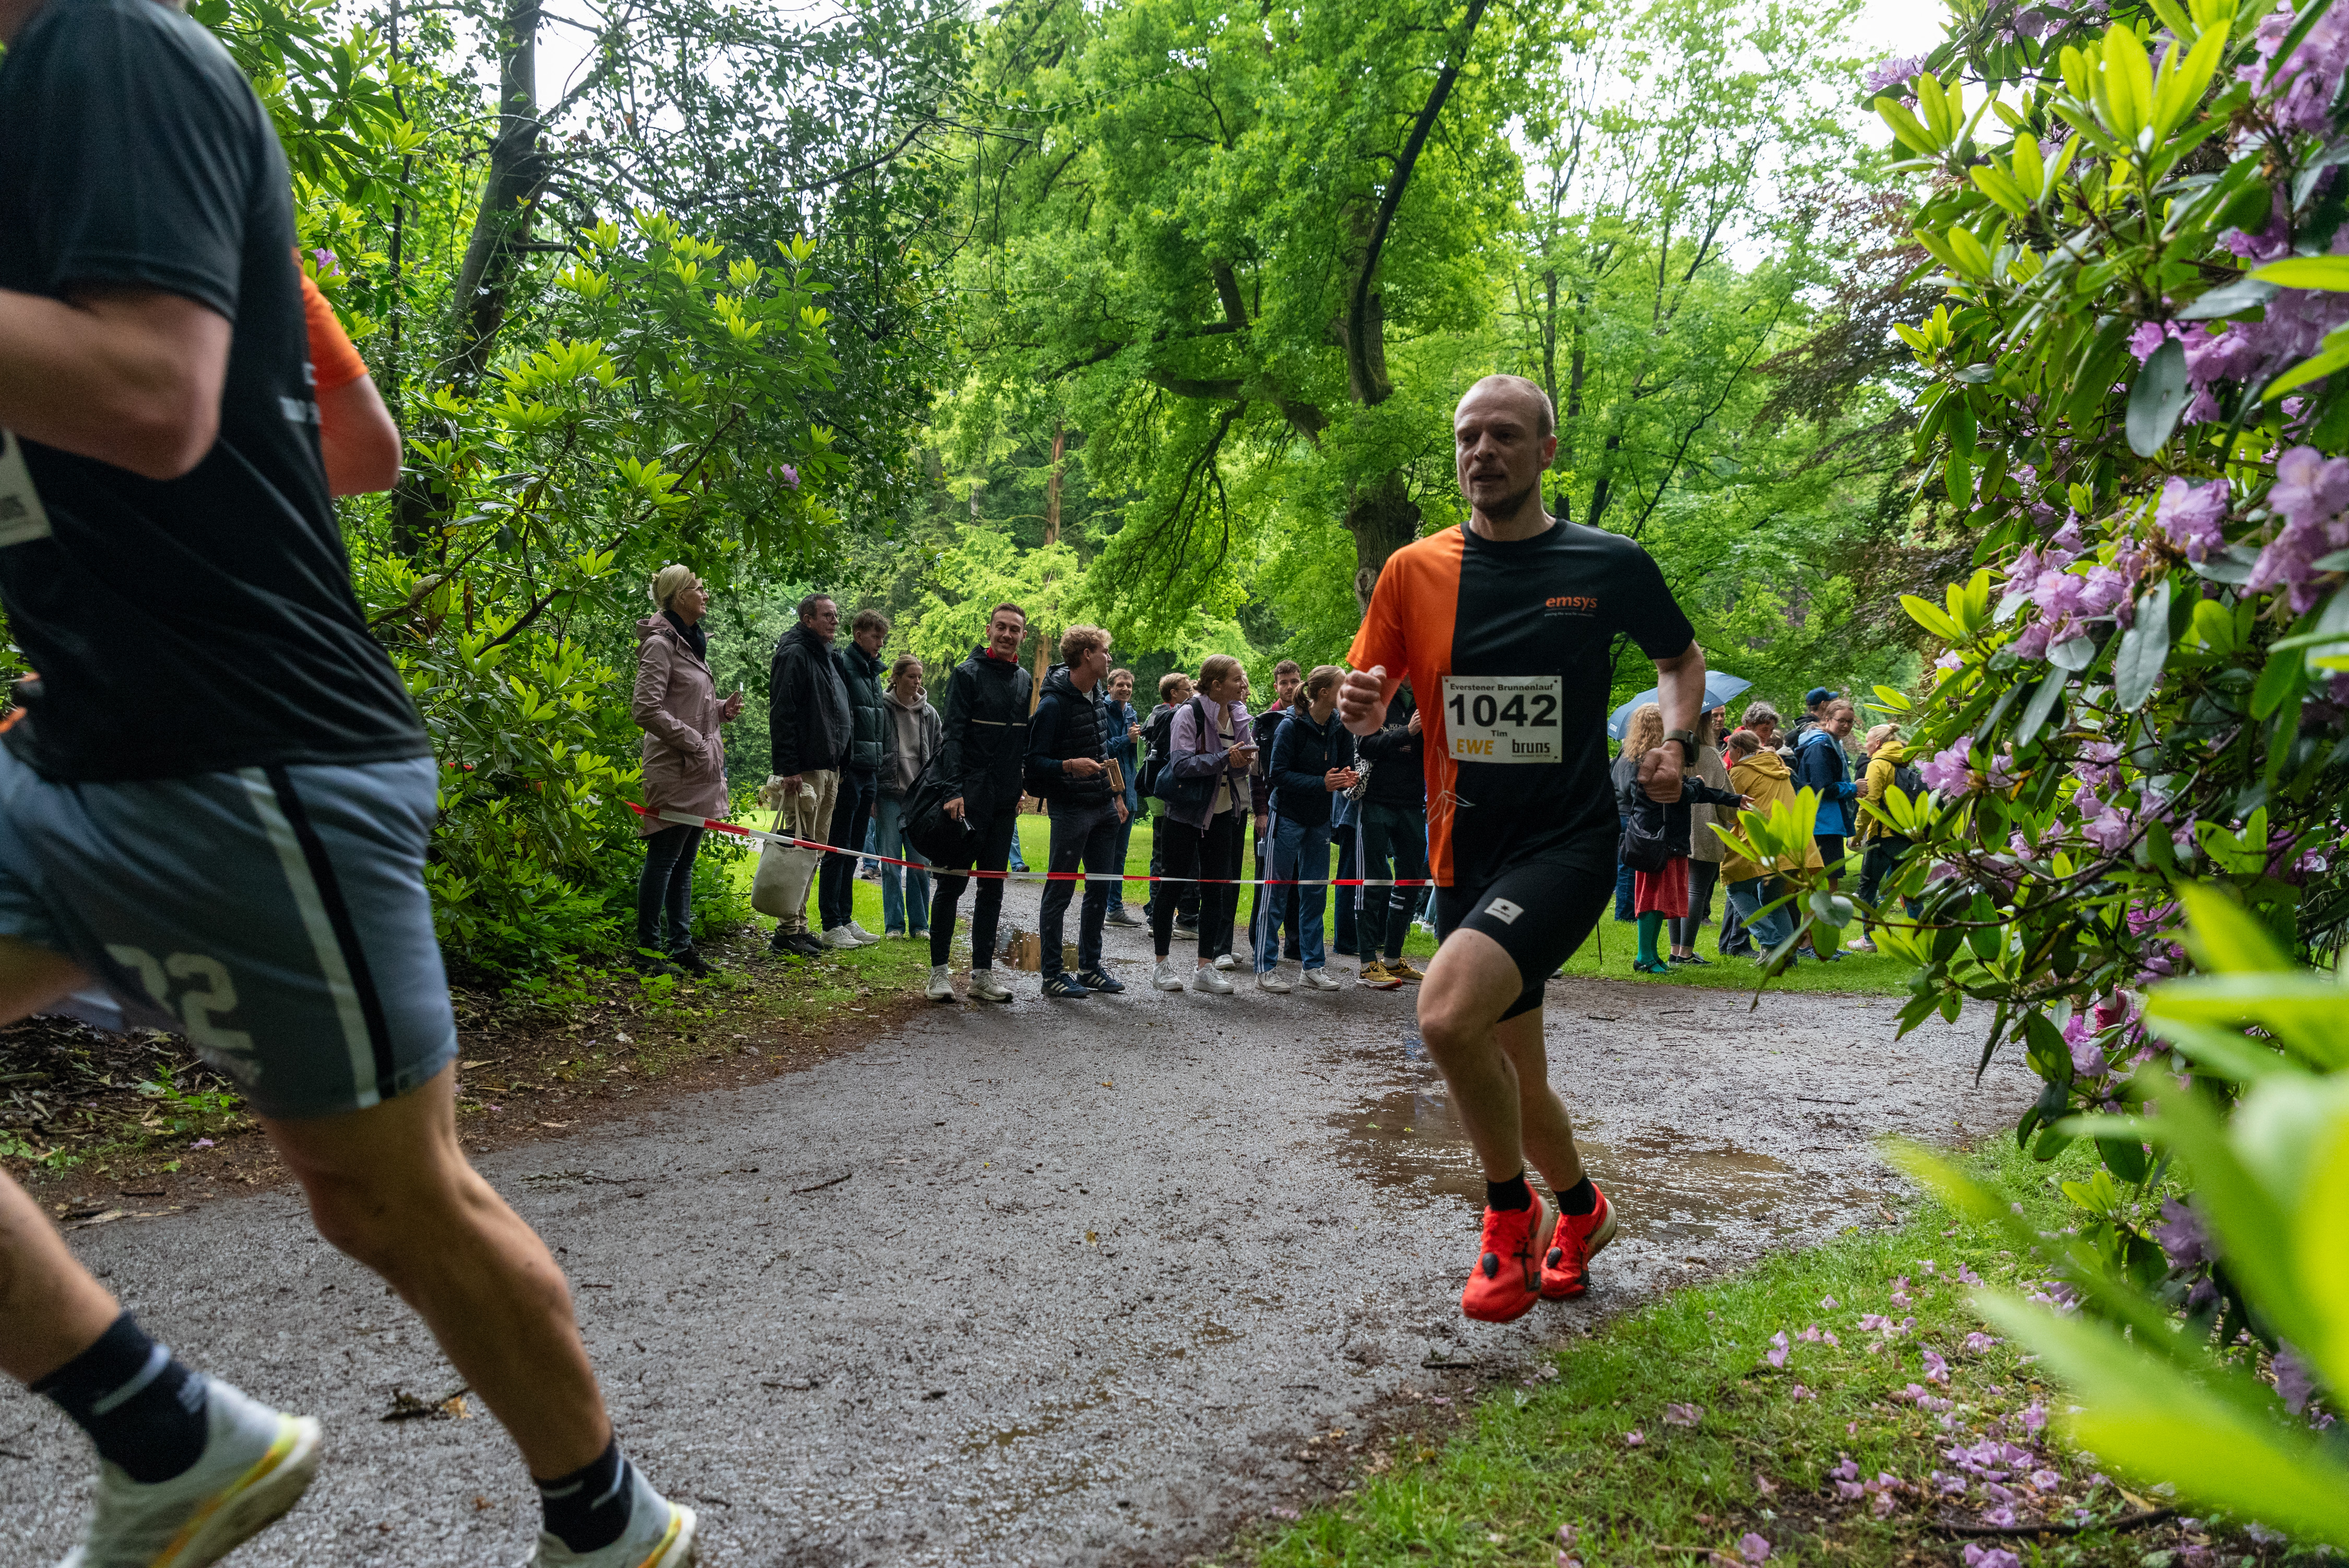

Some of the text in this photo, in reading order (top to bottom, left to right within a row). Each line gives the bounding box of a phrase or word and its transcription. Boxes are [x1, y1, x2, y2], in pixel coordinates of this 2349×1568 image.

[1546, 596, 1597, 611] emsys
[1449, 694, 1557, 727] 1042
[1457, 739, 1550, 755] EWE bruns
